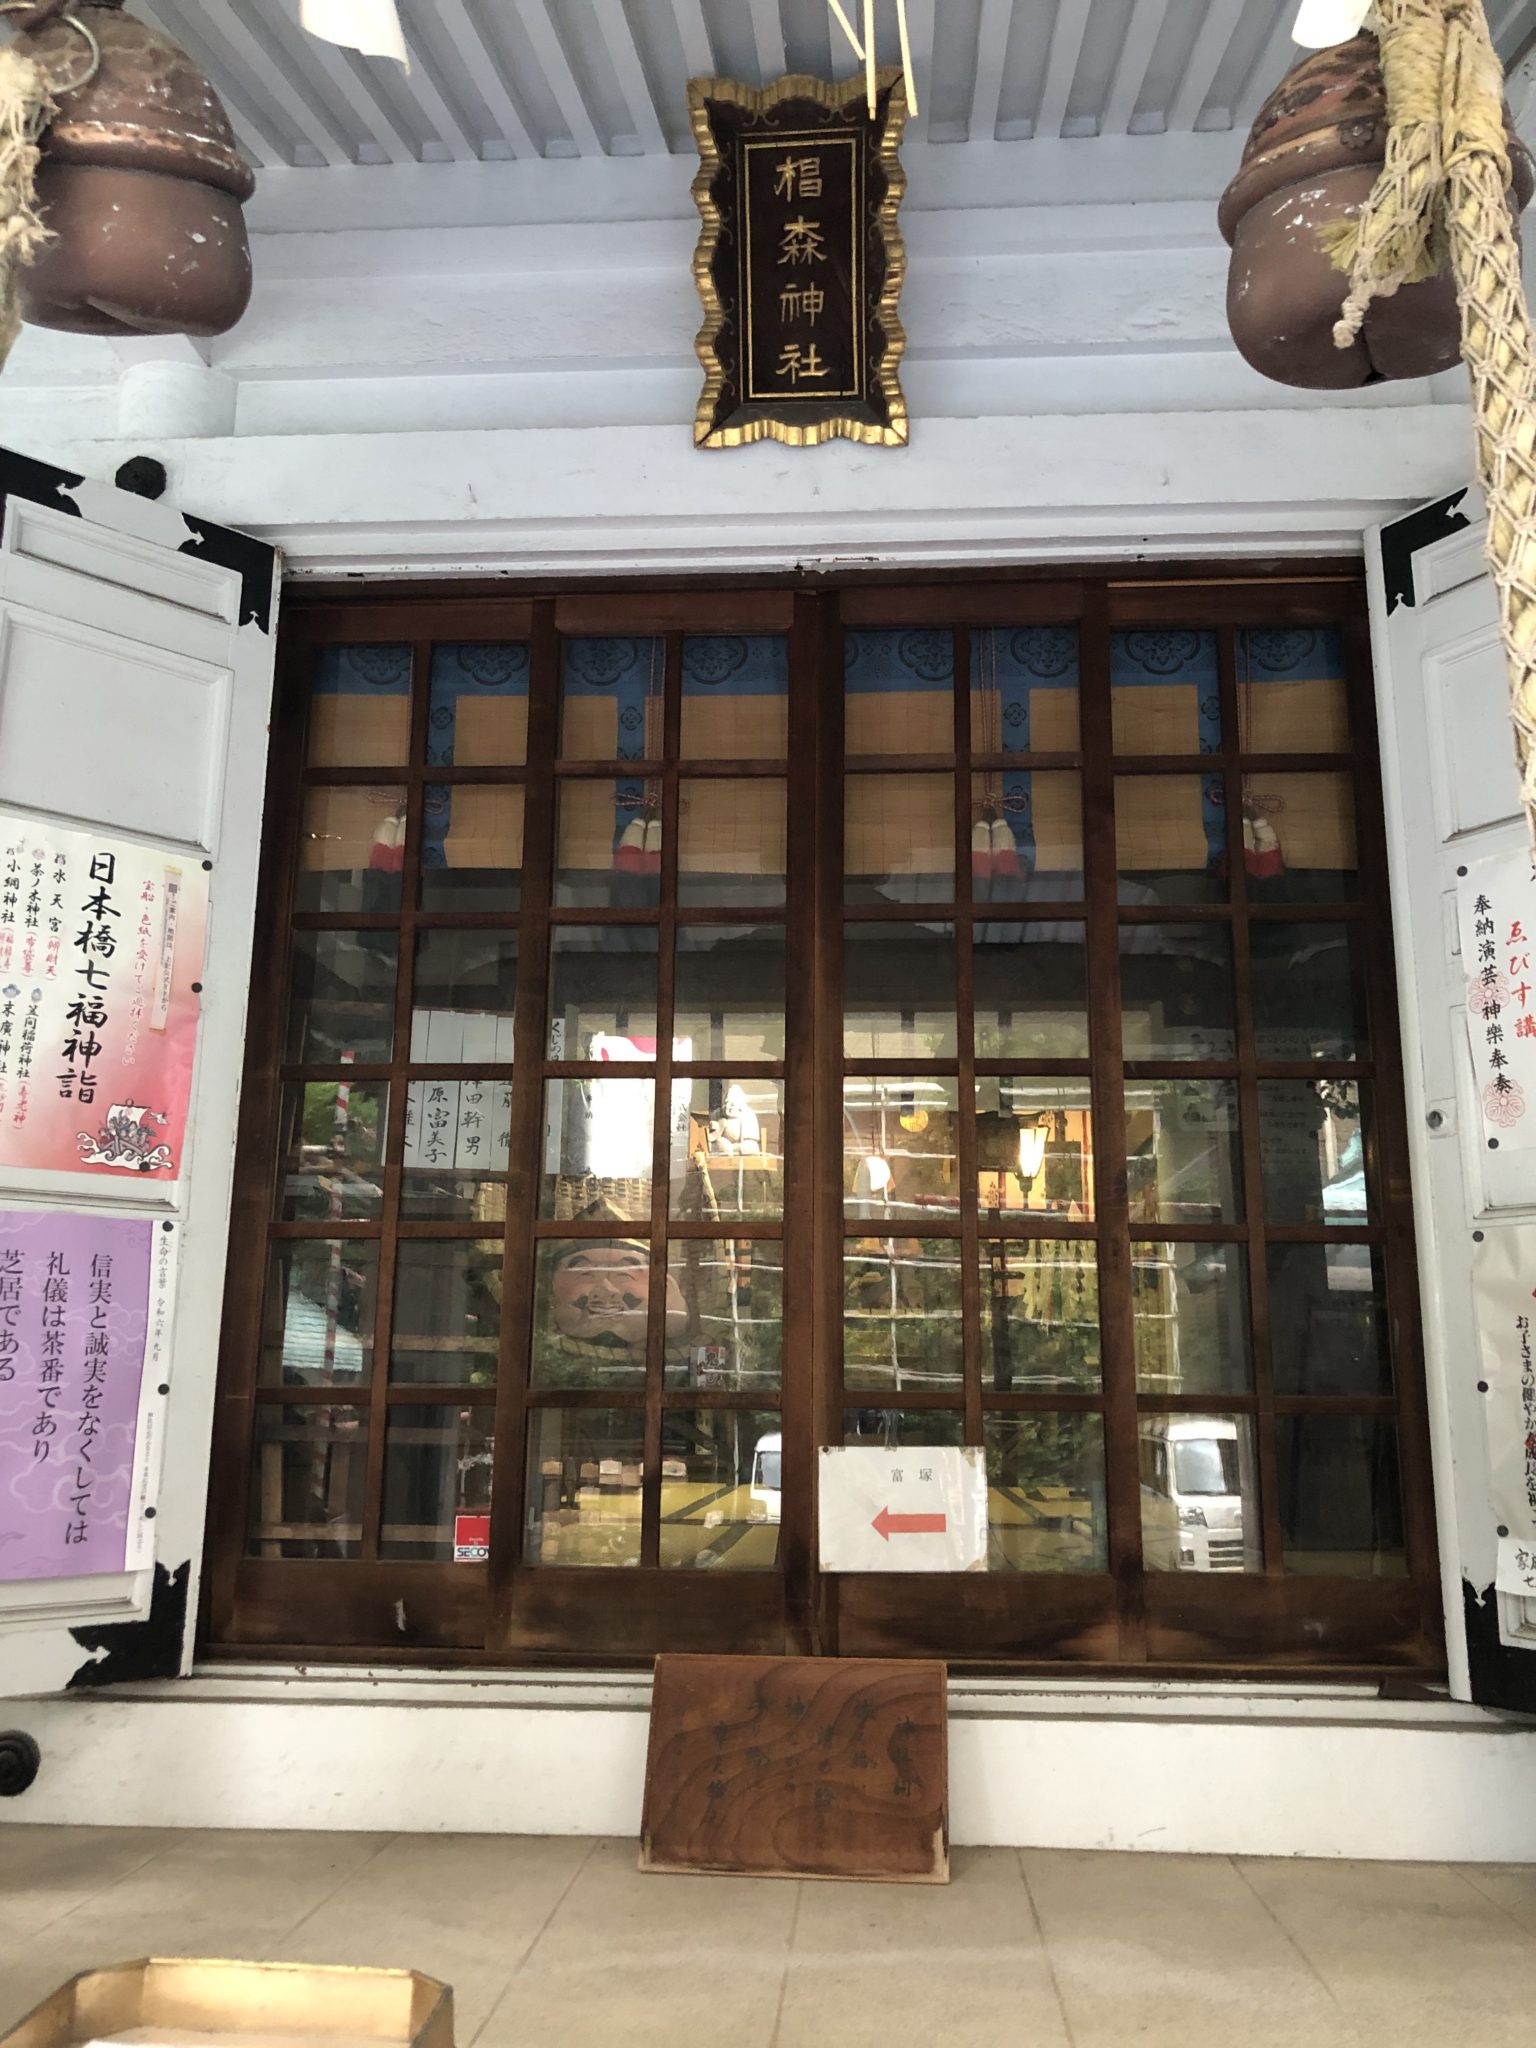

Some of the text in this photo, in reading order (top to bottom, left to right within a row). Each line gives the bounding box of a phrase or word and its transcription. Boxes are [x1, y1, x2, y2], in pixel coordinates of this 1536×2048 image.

[774, 155, 830, 385] 椙森神社
[56, 852, 122, 1105] 日本橋七福神詣
[0, 1248, 25, 1383] 芝居である
[31, 1250, 71, 1464] 礼儀は茶番であり
[65, 1253, 113, 1545] 信実と誠実をなくしては
